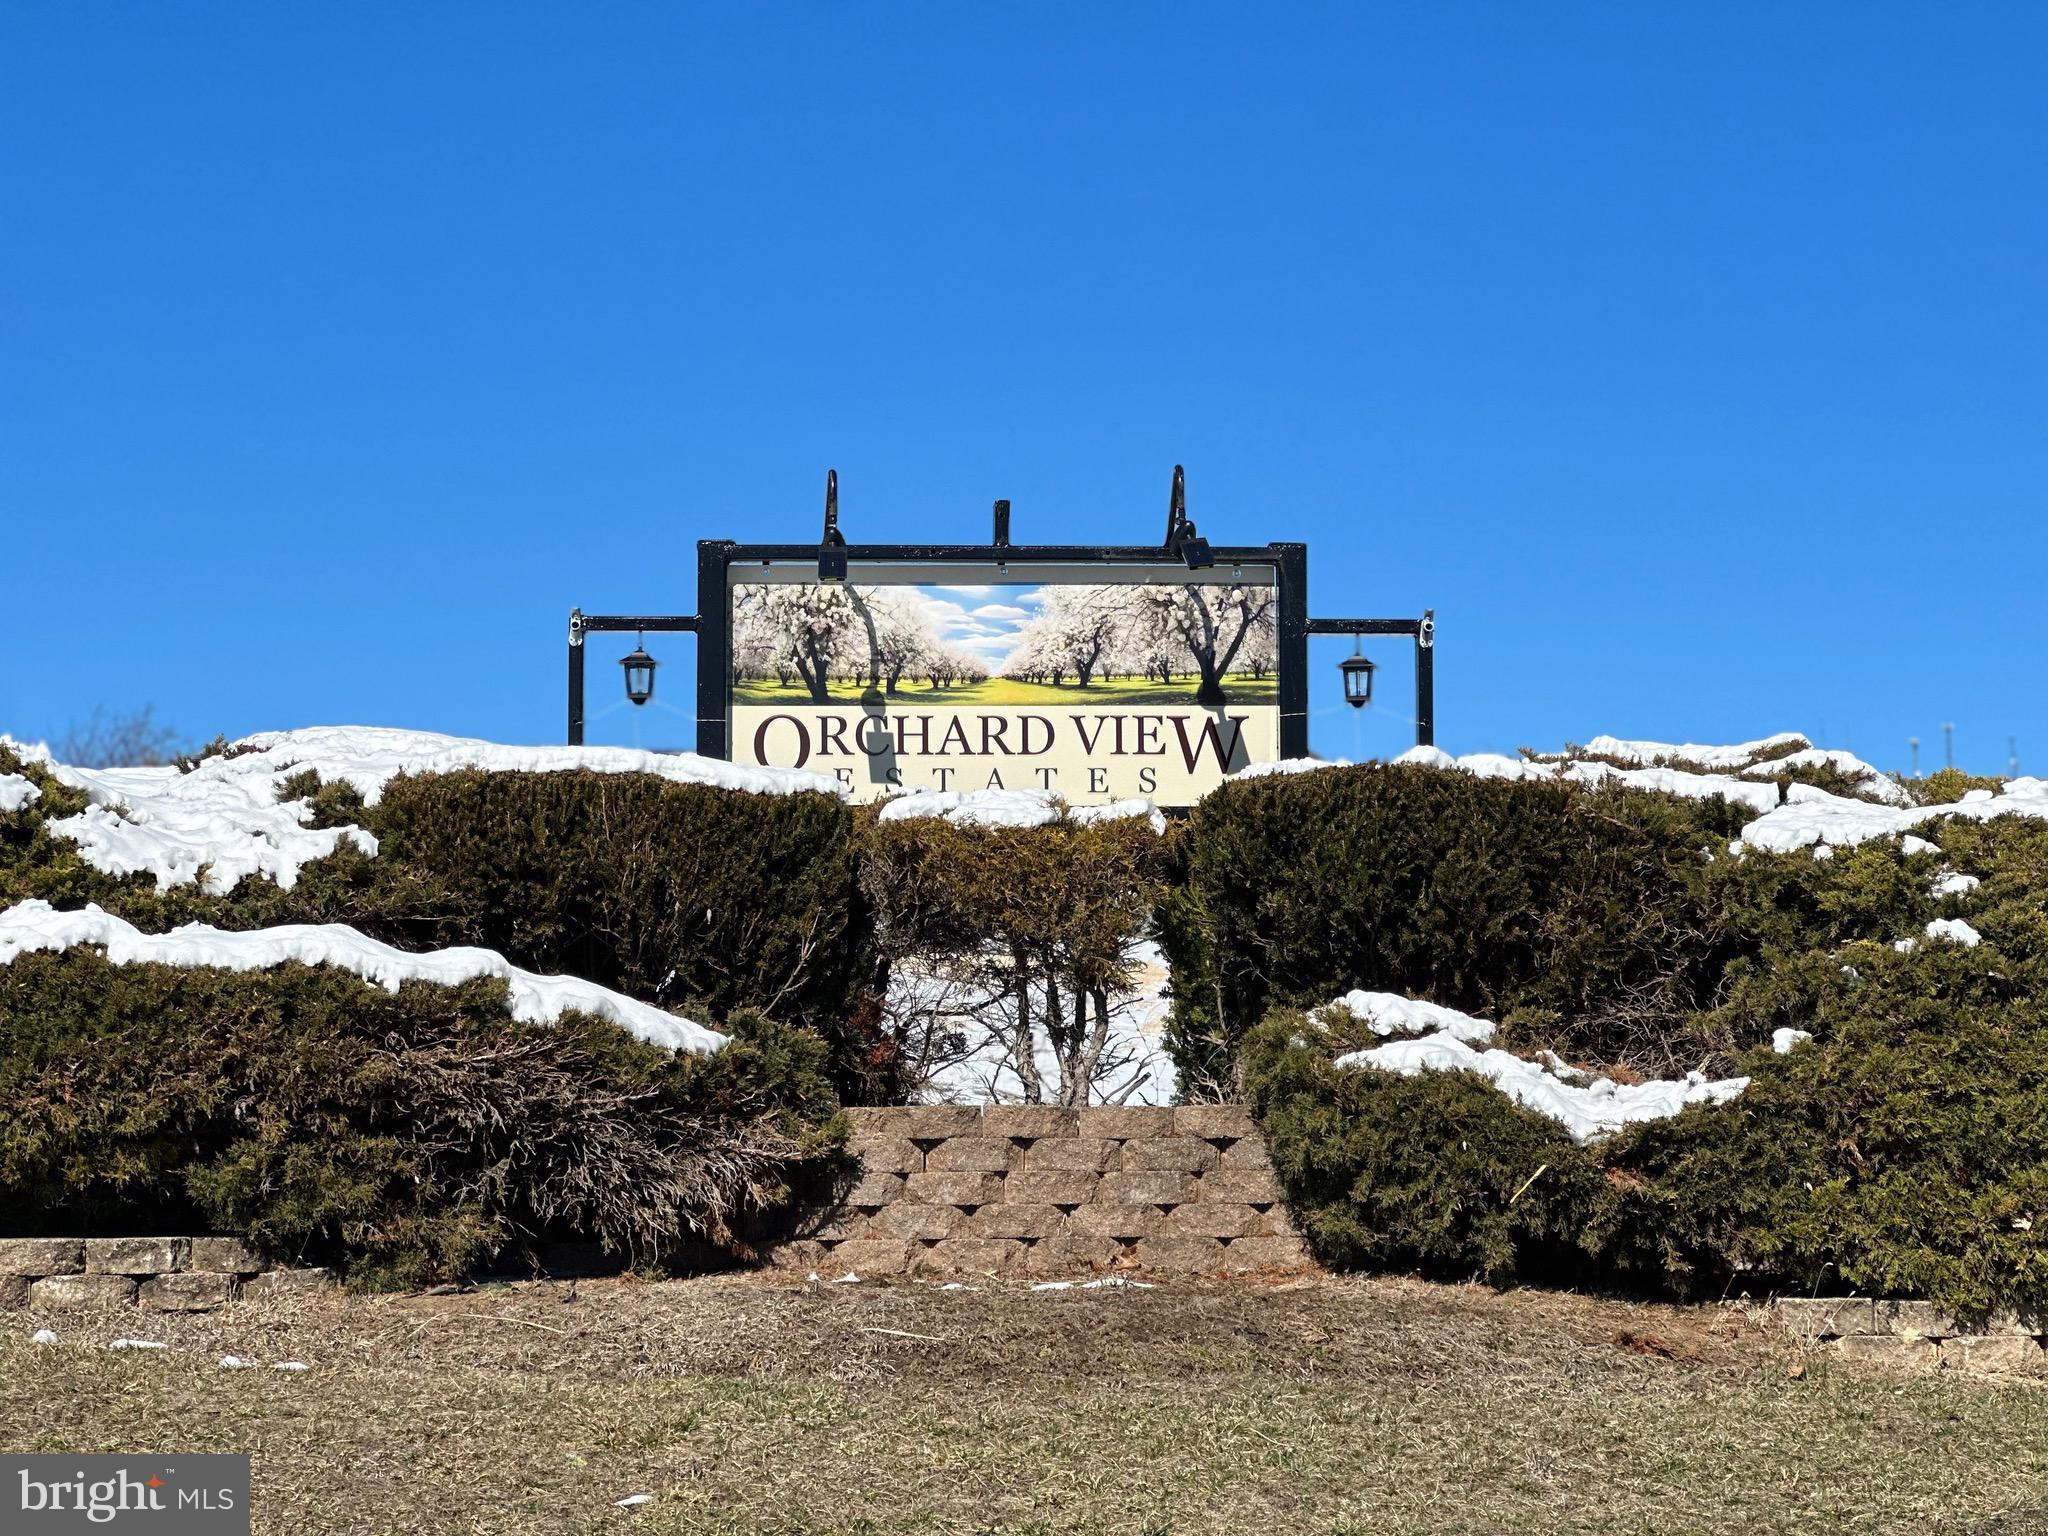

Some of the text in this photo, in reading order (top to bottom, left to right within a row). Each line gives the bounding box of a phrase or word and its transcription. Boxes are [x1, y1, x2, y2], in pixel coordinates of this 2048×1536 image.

[753, 714, 1250, 775] ORCHARD VIEW
[834, 767, 1157, 793] ESTATES
